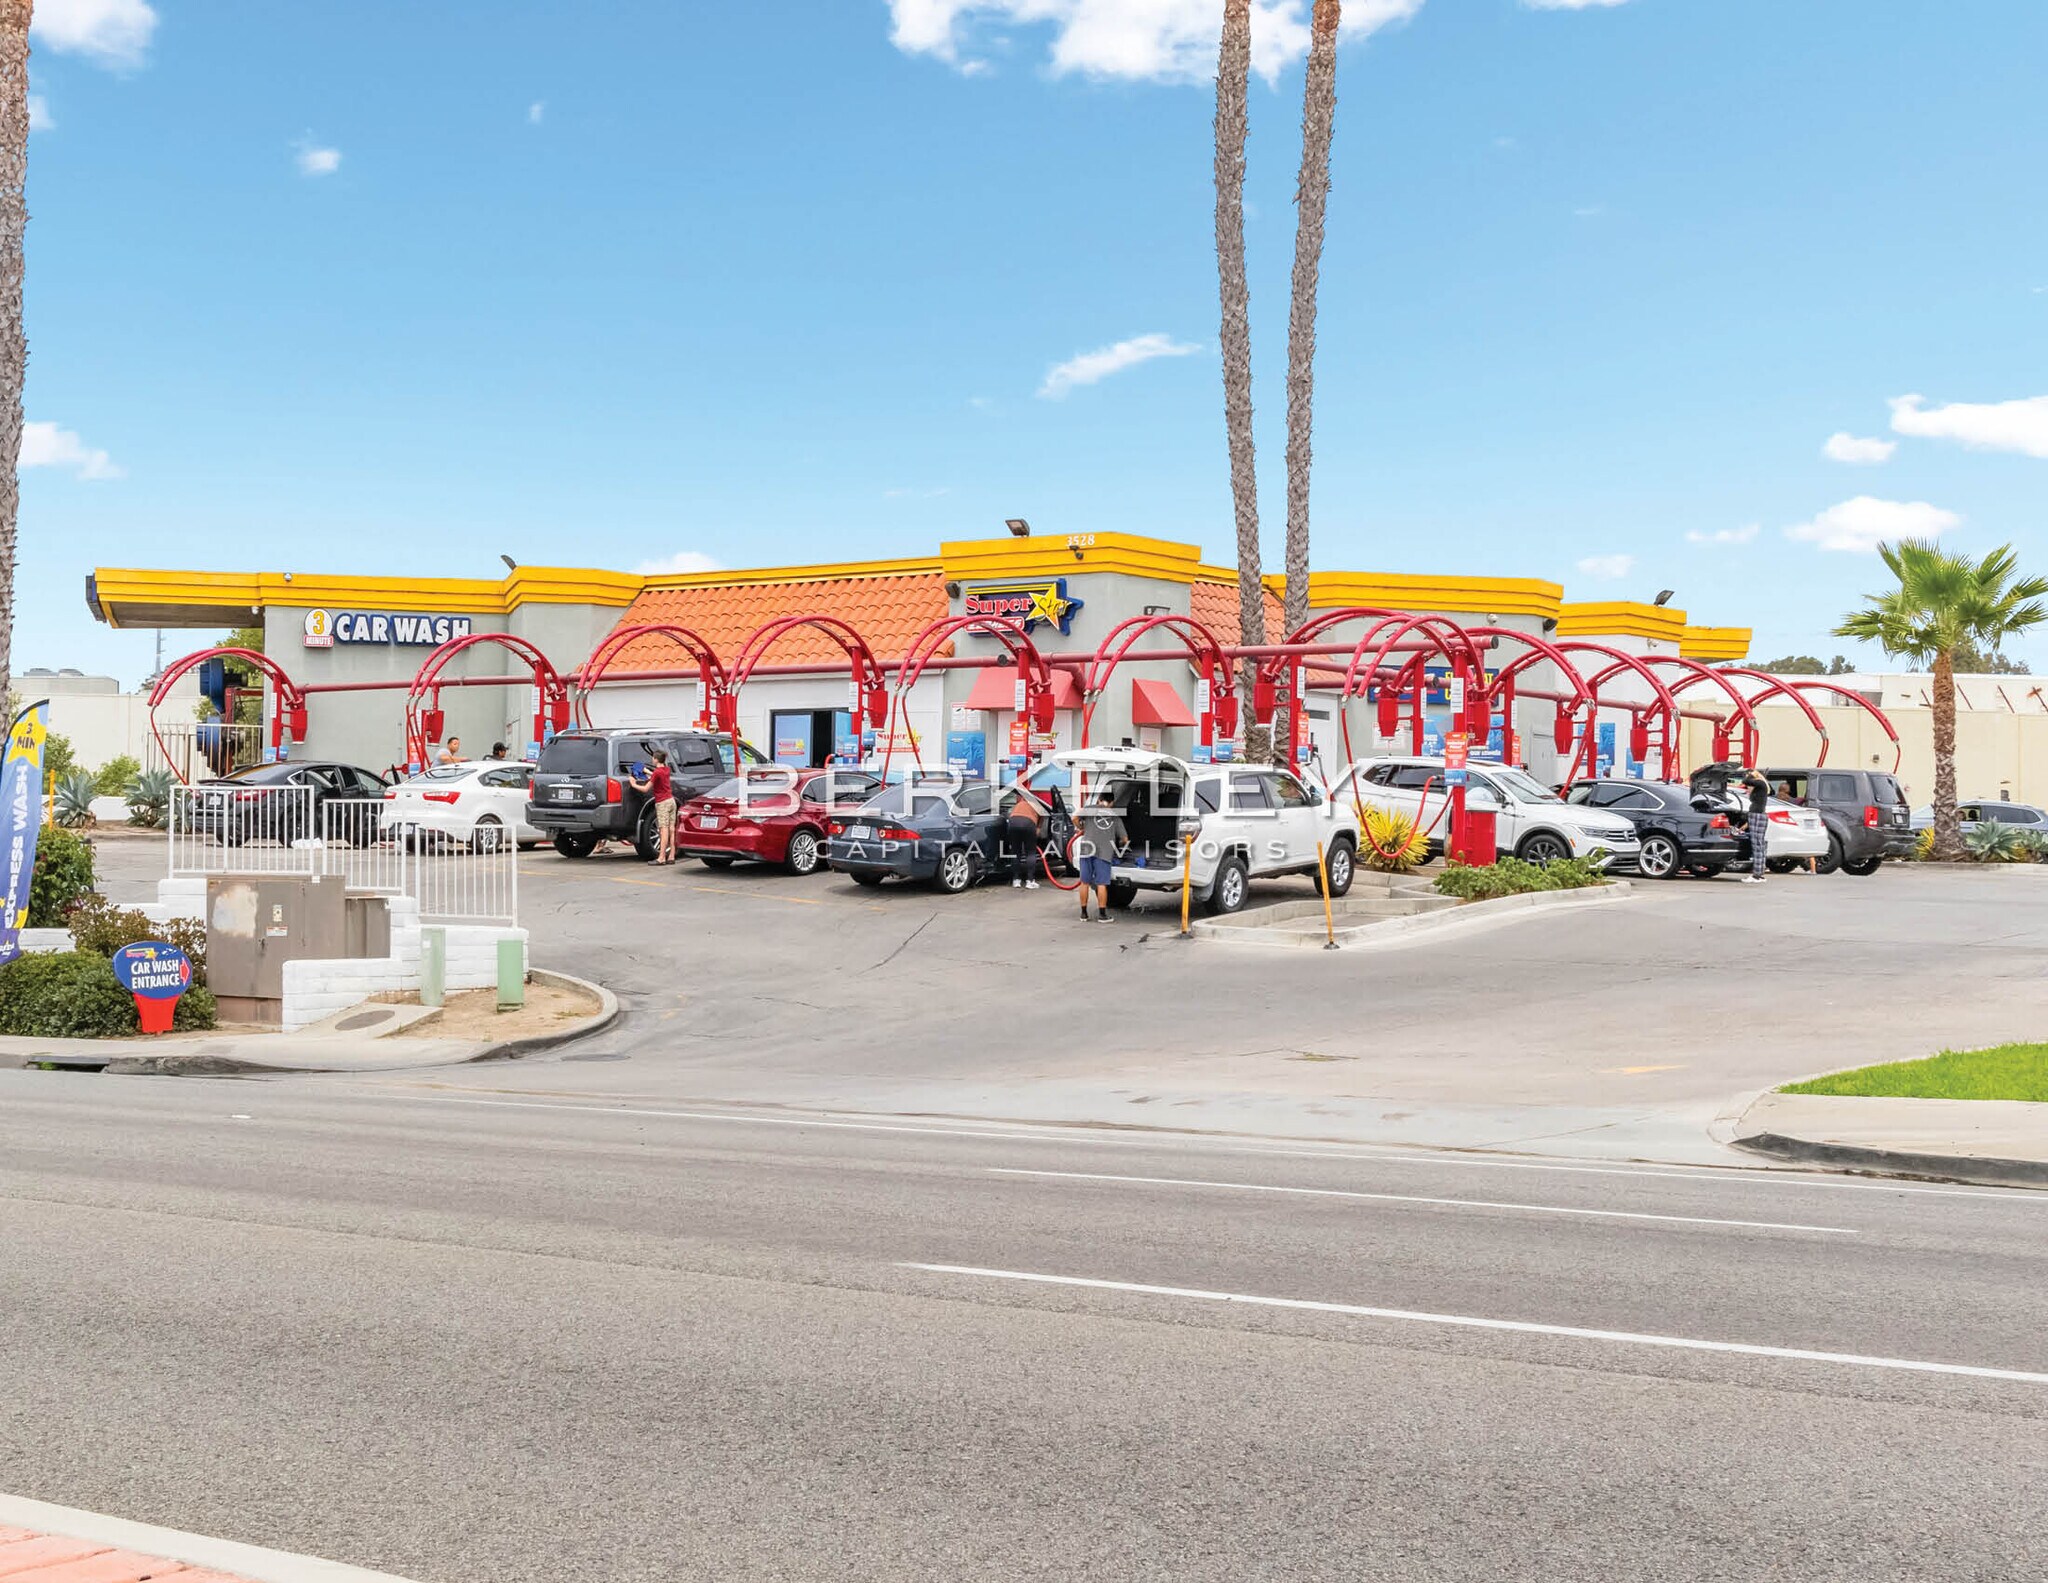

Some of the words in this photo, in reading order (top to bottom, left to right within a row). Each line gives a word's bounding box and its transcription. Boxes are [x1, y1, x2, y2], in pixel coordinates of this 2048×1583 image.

[1067, 534, 1095, 547] 3528
[965, 595, 1033, 616] Super
[312, 611, 325, 635] 3
[336, 615, 389, 641] CAR
[394, 617, 470, 645] WASH
[306, 637, 331, 646] MINUTE
[26, 722, 33, 734] 3
[17, 736, 35, 749] MIN
[13, 765, 28, 831] WASH
[4, 835, 24, 928] EXPRESS
[131, 961, 151, 975] CAR
[152, 959, 179, 974] WASH
[132, 973, 180, 989] ENTRANCE
